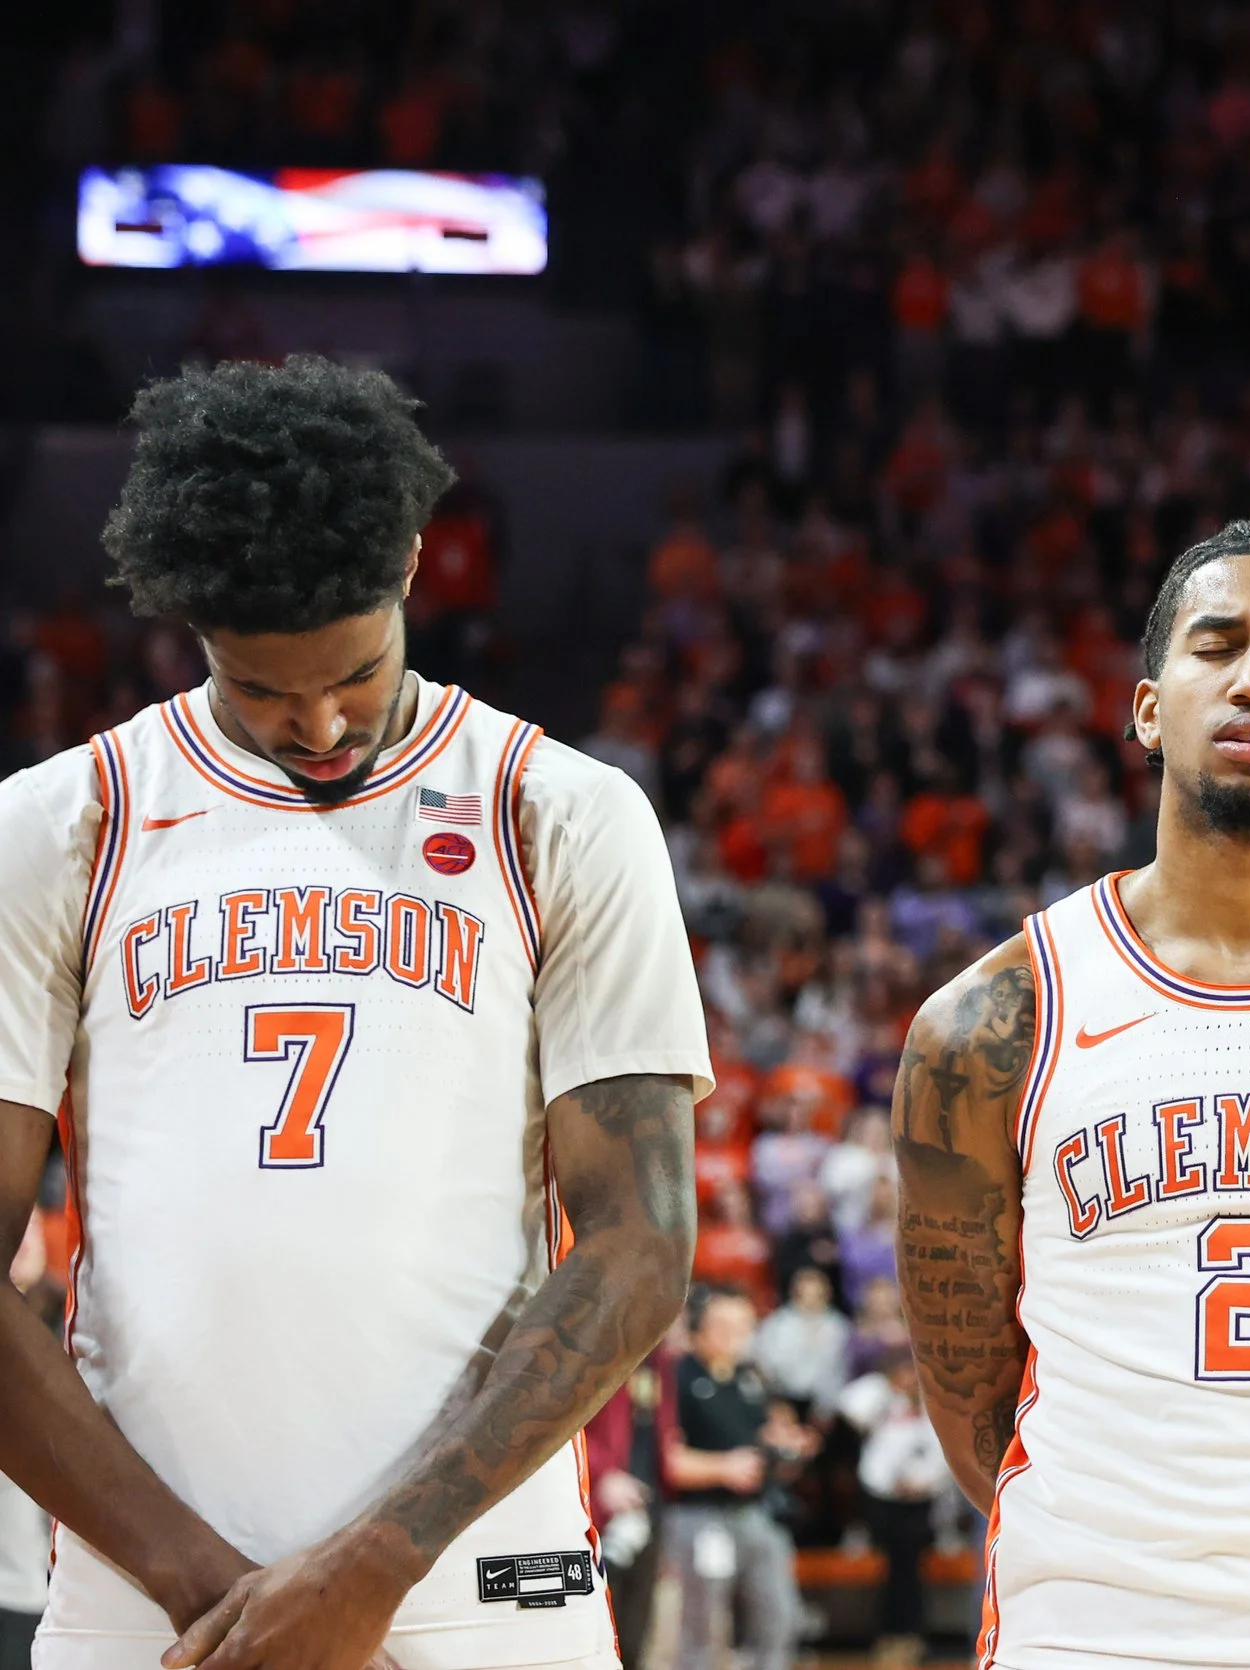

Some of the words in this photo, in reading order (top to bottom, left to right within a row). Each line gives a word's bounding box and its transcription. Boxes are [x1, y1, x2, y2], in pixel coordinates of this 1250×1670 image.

[119, 886, 485, 1020] CLEMSON
[243, 1003, 356, 1169] 7
[518, 1557, 560, 1566] ENGINEERED
[567, 1563, 582, 1581] 48
[486, 1582, 515, 1590] TEAM
